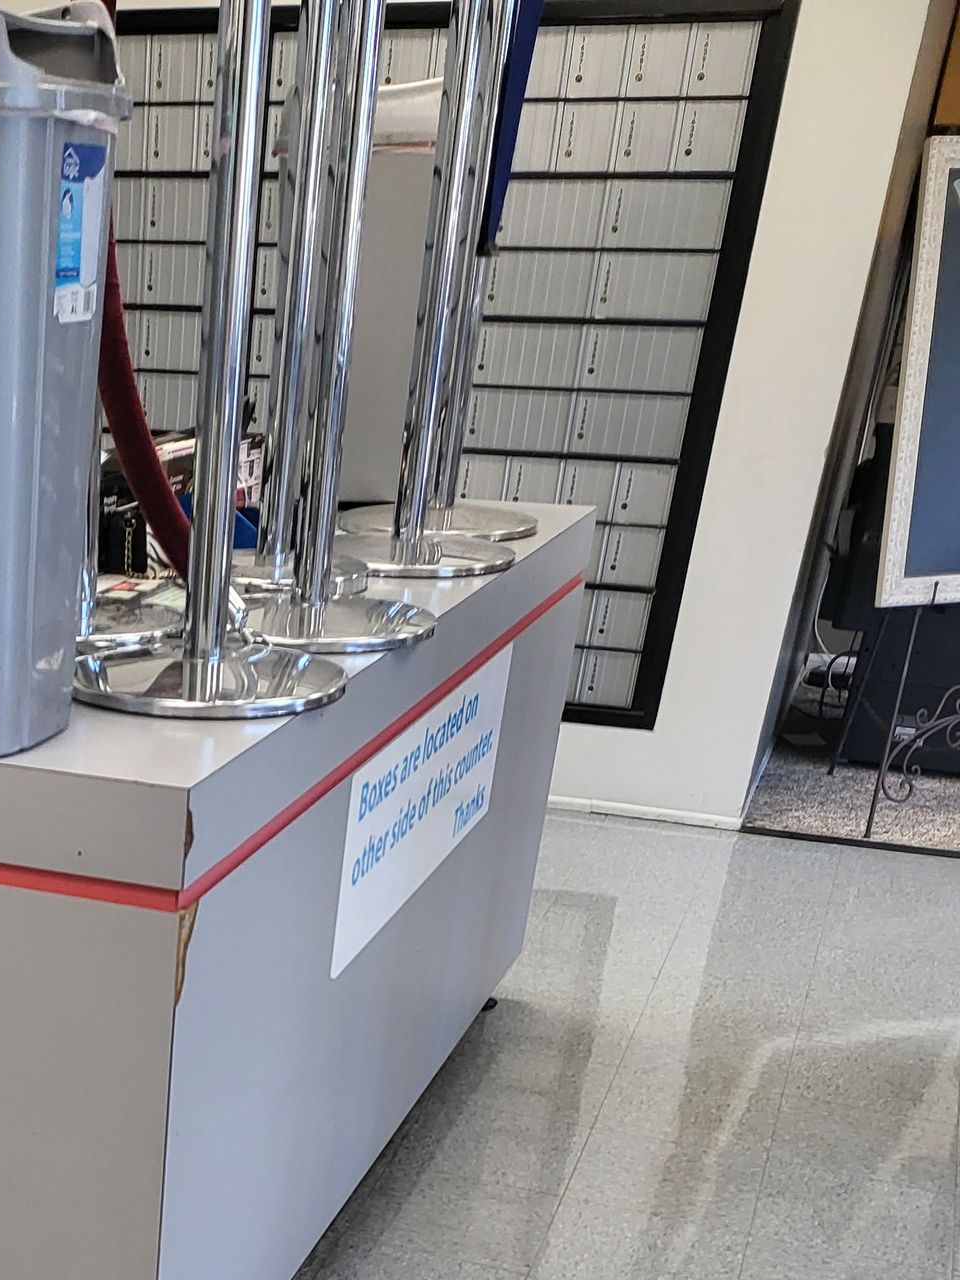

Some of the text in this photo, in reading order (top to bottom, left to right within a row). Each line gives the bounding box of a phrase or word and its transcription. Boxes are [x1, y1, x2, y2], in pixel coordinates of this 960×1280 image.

[351, 728, 494, 887] other side of this counter.
[358, 692, 480, 823] Boxes are located on
[452, 783, 486, 838] Thanks
